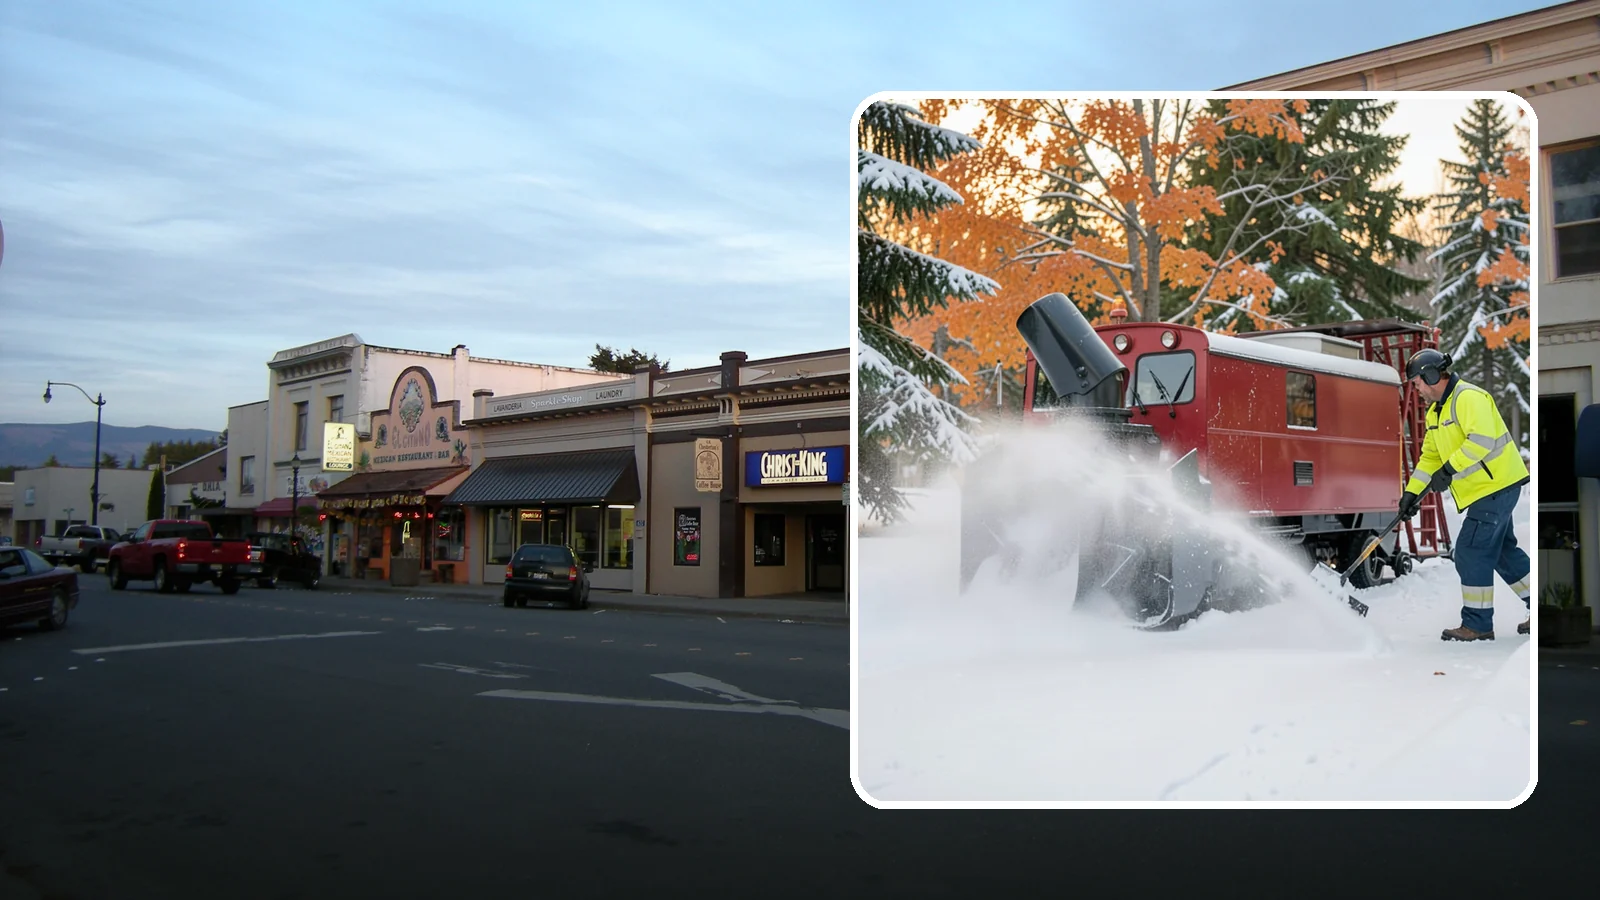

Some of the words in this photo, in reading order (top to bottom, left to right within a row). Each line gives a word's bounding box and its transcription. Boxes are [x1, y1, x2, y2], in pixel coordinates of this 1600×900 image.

[493, 402, 522, 412] LAVANDERIA
[530, 398, 560, 409] Sparkle
[561, 394, 582, 406] Shop
[595, 389, 623, 400] LAUNDRY
[374, 454, 396, 464] MEXICAN
[398, 451, 433, 462] RESTAURANT
[438, 450, 449, 459] BAR
[761, 451, 797, 478] CHRIST
[799, 449, 827, 476] KING
